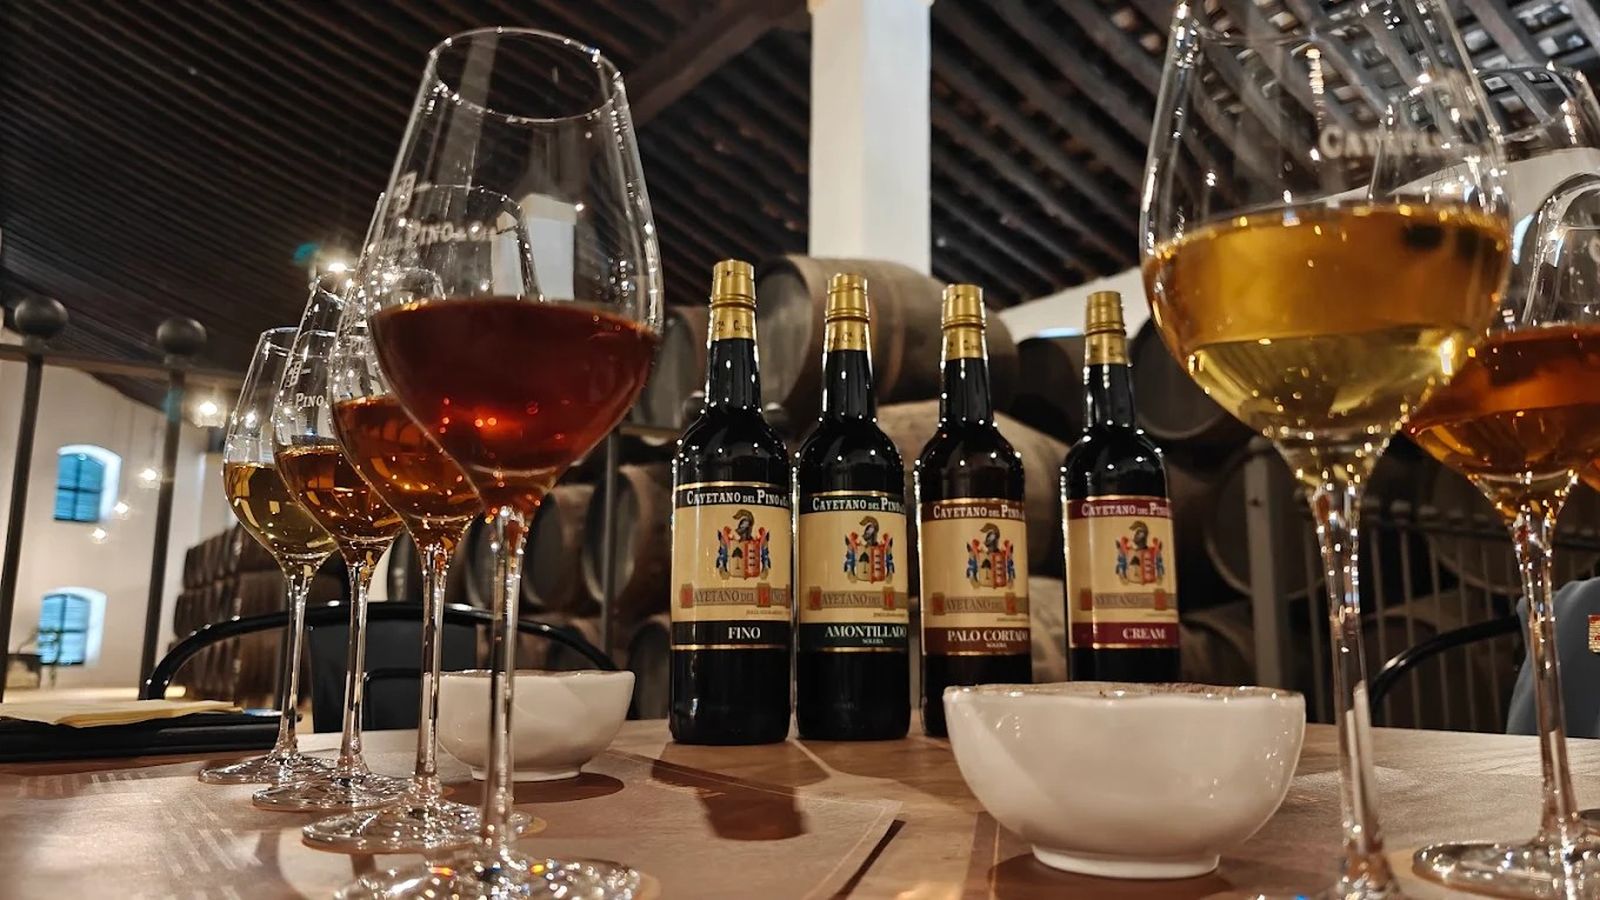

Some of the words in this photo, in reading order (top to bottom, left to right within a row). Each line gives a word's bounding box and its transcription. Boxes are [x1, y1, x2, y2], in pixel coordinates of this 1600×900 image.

[295, 392, 325, 409] PINO
[687, 490, 741, 505] CAYETANO
[742, 495, 755, 504] DEL
[756, 489, 779, 505] PINO
[812, 497, 867, 511] CAYETANO
[933, 505, 988, 519] CAYETANO
[1081, 502, 1137, 517] CAYETANO
[728, 626, 761, 640] FINO
[825, 625, 907, 638] AMONTILLADO
[947, 629, 981, 642] PALO
[982, 629, 1028, 642] CORTADO
[1122, 628, 1166, 640] CREAM
